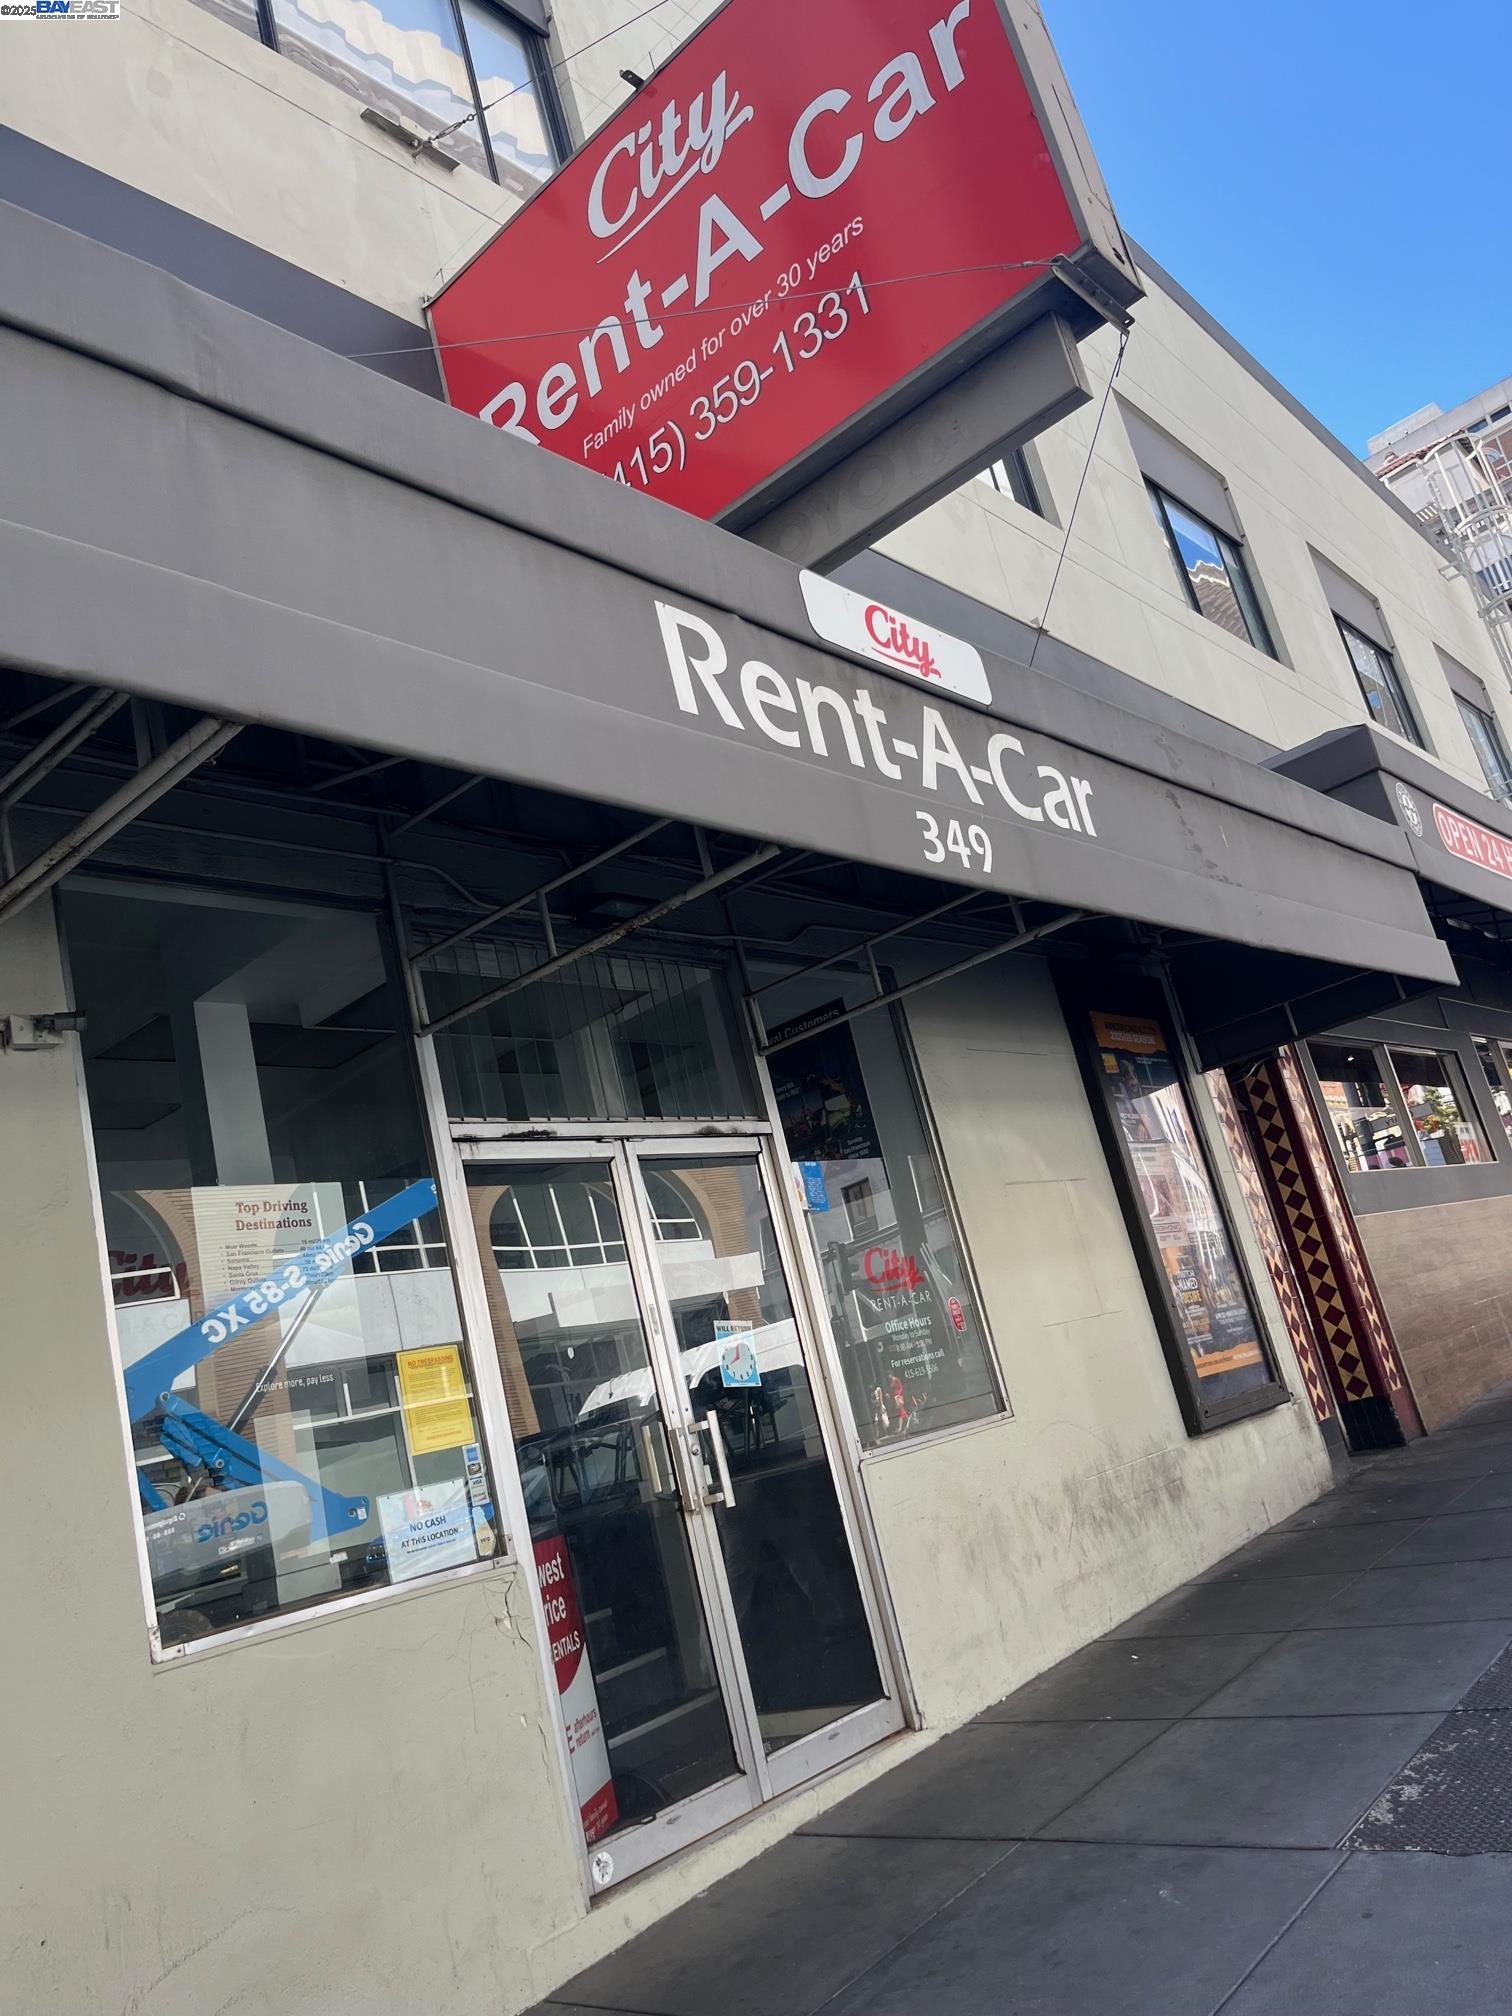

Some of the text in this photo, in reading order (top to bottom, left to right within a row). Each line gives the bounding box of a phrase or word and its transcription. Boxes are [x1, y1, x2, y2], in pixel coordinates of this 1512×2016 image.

[586, 70, 755, 264] City
[478, 0, 971, 450] Rent-A-Car
[583, 216, 864, 459] Family owned for over 30 years
[602, 271, 870, 487] 415) 359-1331
[863, 604, 943, 681] City
[654, 600, 1098, 837] Rent-A-Car
[914, 810, 993, 874] 349
[1437, 811, 1484, 862] OPEN
[1481, 834, 1504, 870] 24
[784, 1008, 840, 1039] Customers
[235, 1200, 308, 1216] Top Driving
[235, 1217, 312, 1231] Destinations
[864, 1247, 925, 1293] City
[871, 1290, 932, 1313] RENT-A-CAR
[885, 1316, 932, 1333] Office Hours
[890, 1348, 944, 1368] For reservations call
[284, 1378, 306, 1389] more,
[306, 1376, 319, 1387] pay
[319, 1373, 334, 1383] less
[401, 1539, 410, 1549] AT
[411, 1536, 426, 1546] THIS
[427, 1527, 459, 1542] LOCATION
[409, 1515, 447, 1533] NO CASH
[552, 1630, 580, 1662] ENTALS
